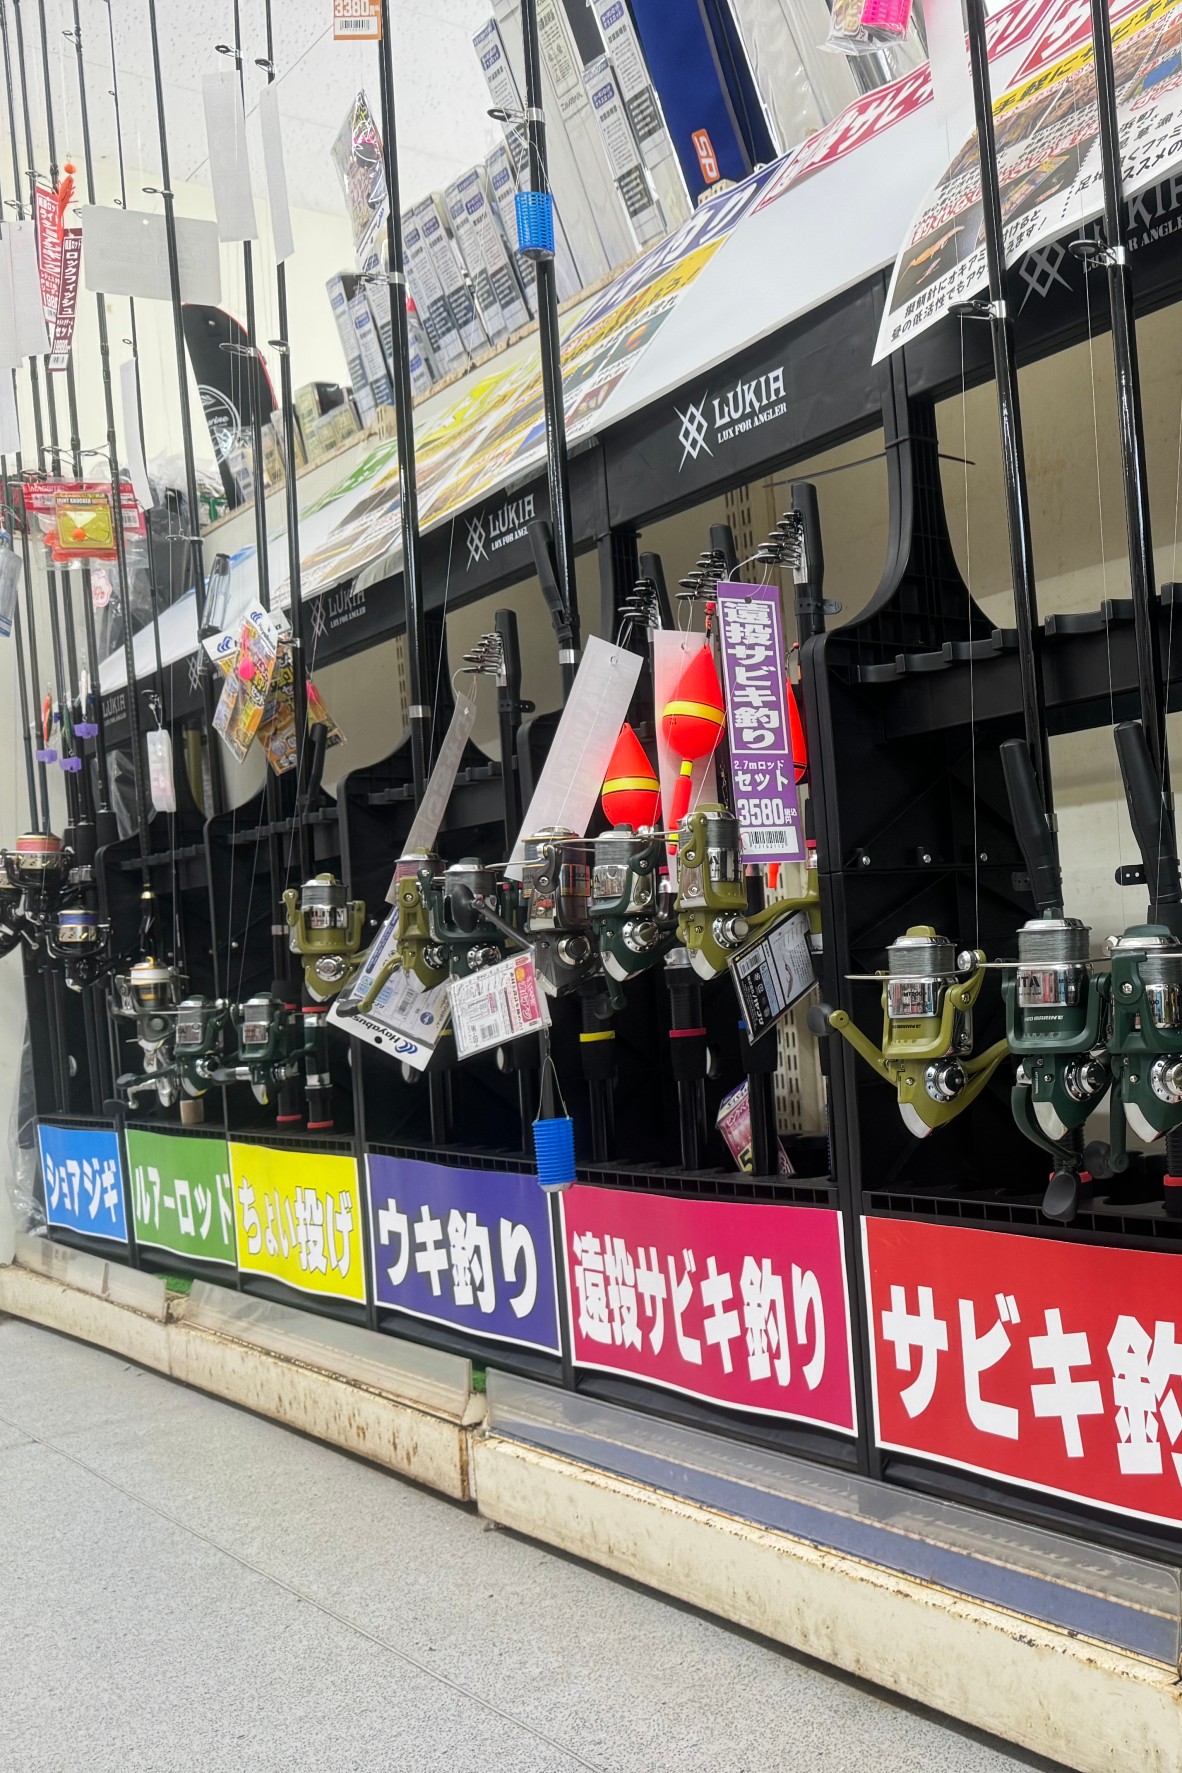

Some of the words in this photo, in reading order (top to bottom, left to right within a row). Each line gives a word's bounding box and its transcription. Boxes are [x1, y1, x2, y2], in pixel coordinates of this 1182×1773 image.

[62, 251, 79, 315] ロックフィッシュ
[55, 326, 73, 338] セット
[711, 366, 787, 429] LUKIA
[717, 428, 735, 445] LUX
[735, 418, 753, 437] FOR
[752, 402, 787, 428] ANGLER
[489, 493, 536, 540] LUKIA
[724, 601, 779, 749] 遠投サビキ釣り
[734, 760, 784, 770] 2.7mロッド
[734, 769, 789, 793] セット
[737, 798, 784, 826] 3580
[352, 1014, 401, 1045] Hayabus
[45, 1152, 121, 1223] ショアジギ
[134, 1164, 233, 1245] ルアーロッド
[238, 1176, 354, 1279] ちょい投げ
[378, 1197, 539, 1319] ウキ釣り
[572, 1230, 828, 1390] 遠投サビキ釣り
